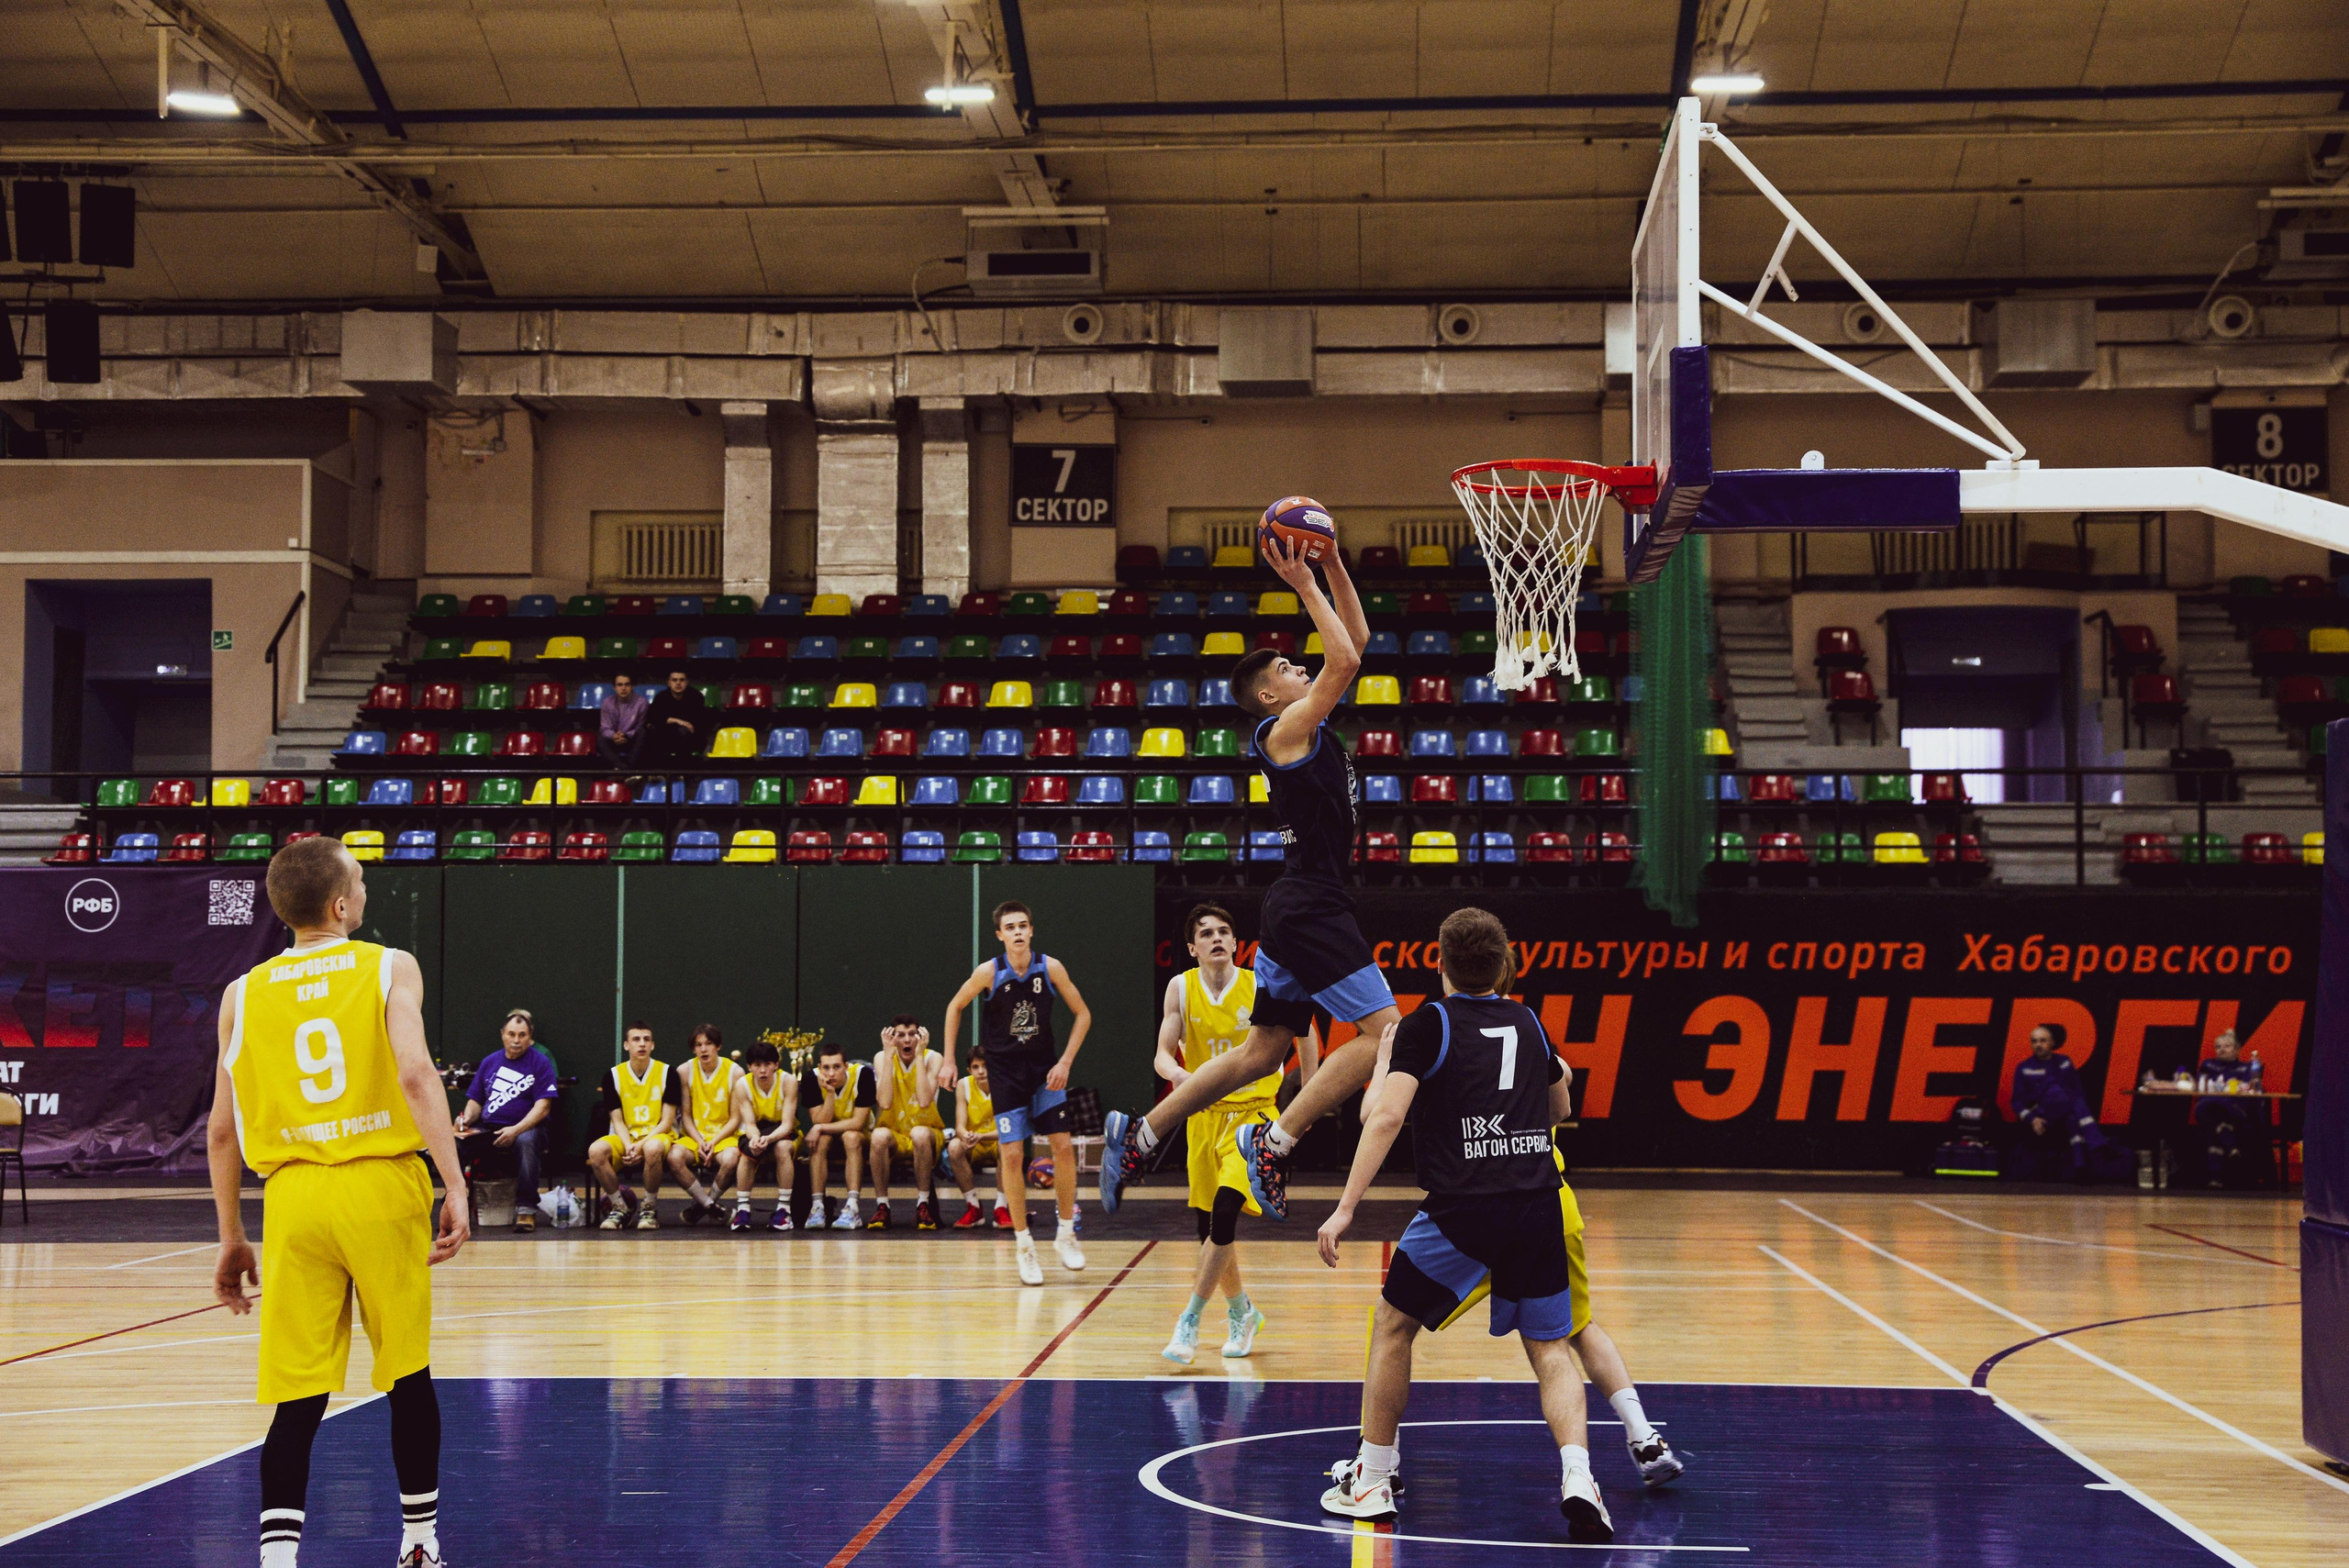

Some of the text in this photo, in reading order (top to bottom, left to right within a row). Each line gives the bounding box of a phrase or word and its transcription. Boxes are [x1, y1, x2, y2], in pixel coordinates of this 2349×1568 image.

[2256, 413, 2285, 459] 8
[1052, 450, 1076, 493] 7
[1017, 498, 1108, 521] СЕКТОР
[72, 897, 113, 913] РФБ
[269, 951, 356, 984] ХАБАРОВСКИЙ
[1508, 934, 2292, 982] ультуры и спорта Хабаровского
[296, 976, 329, 1002] КРАЙ
[1033, 977, 1042, 993] 8
[295, 1018, 347, 1104] 9
[1479, 1025, 1518, 1090] 7
[487, 1074, 536, 1114] adidas
[340, 1109, 392, 1137] РОССИИ
[633, 1105, 650, 1122] 13
[702, 1102, 710, 1118] 7
[998, 1117, 1011, 1133] 8
[1464, 1139, 1509, 1160] ВАГОН
